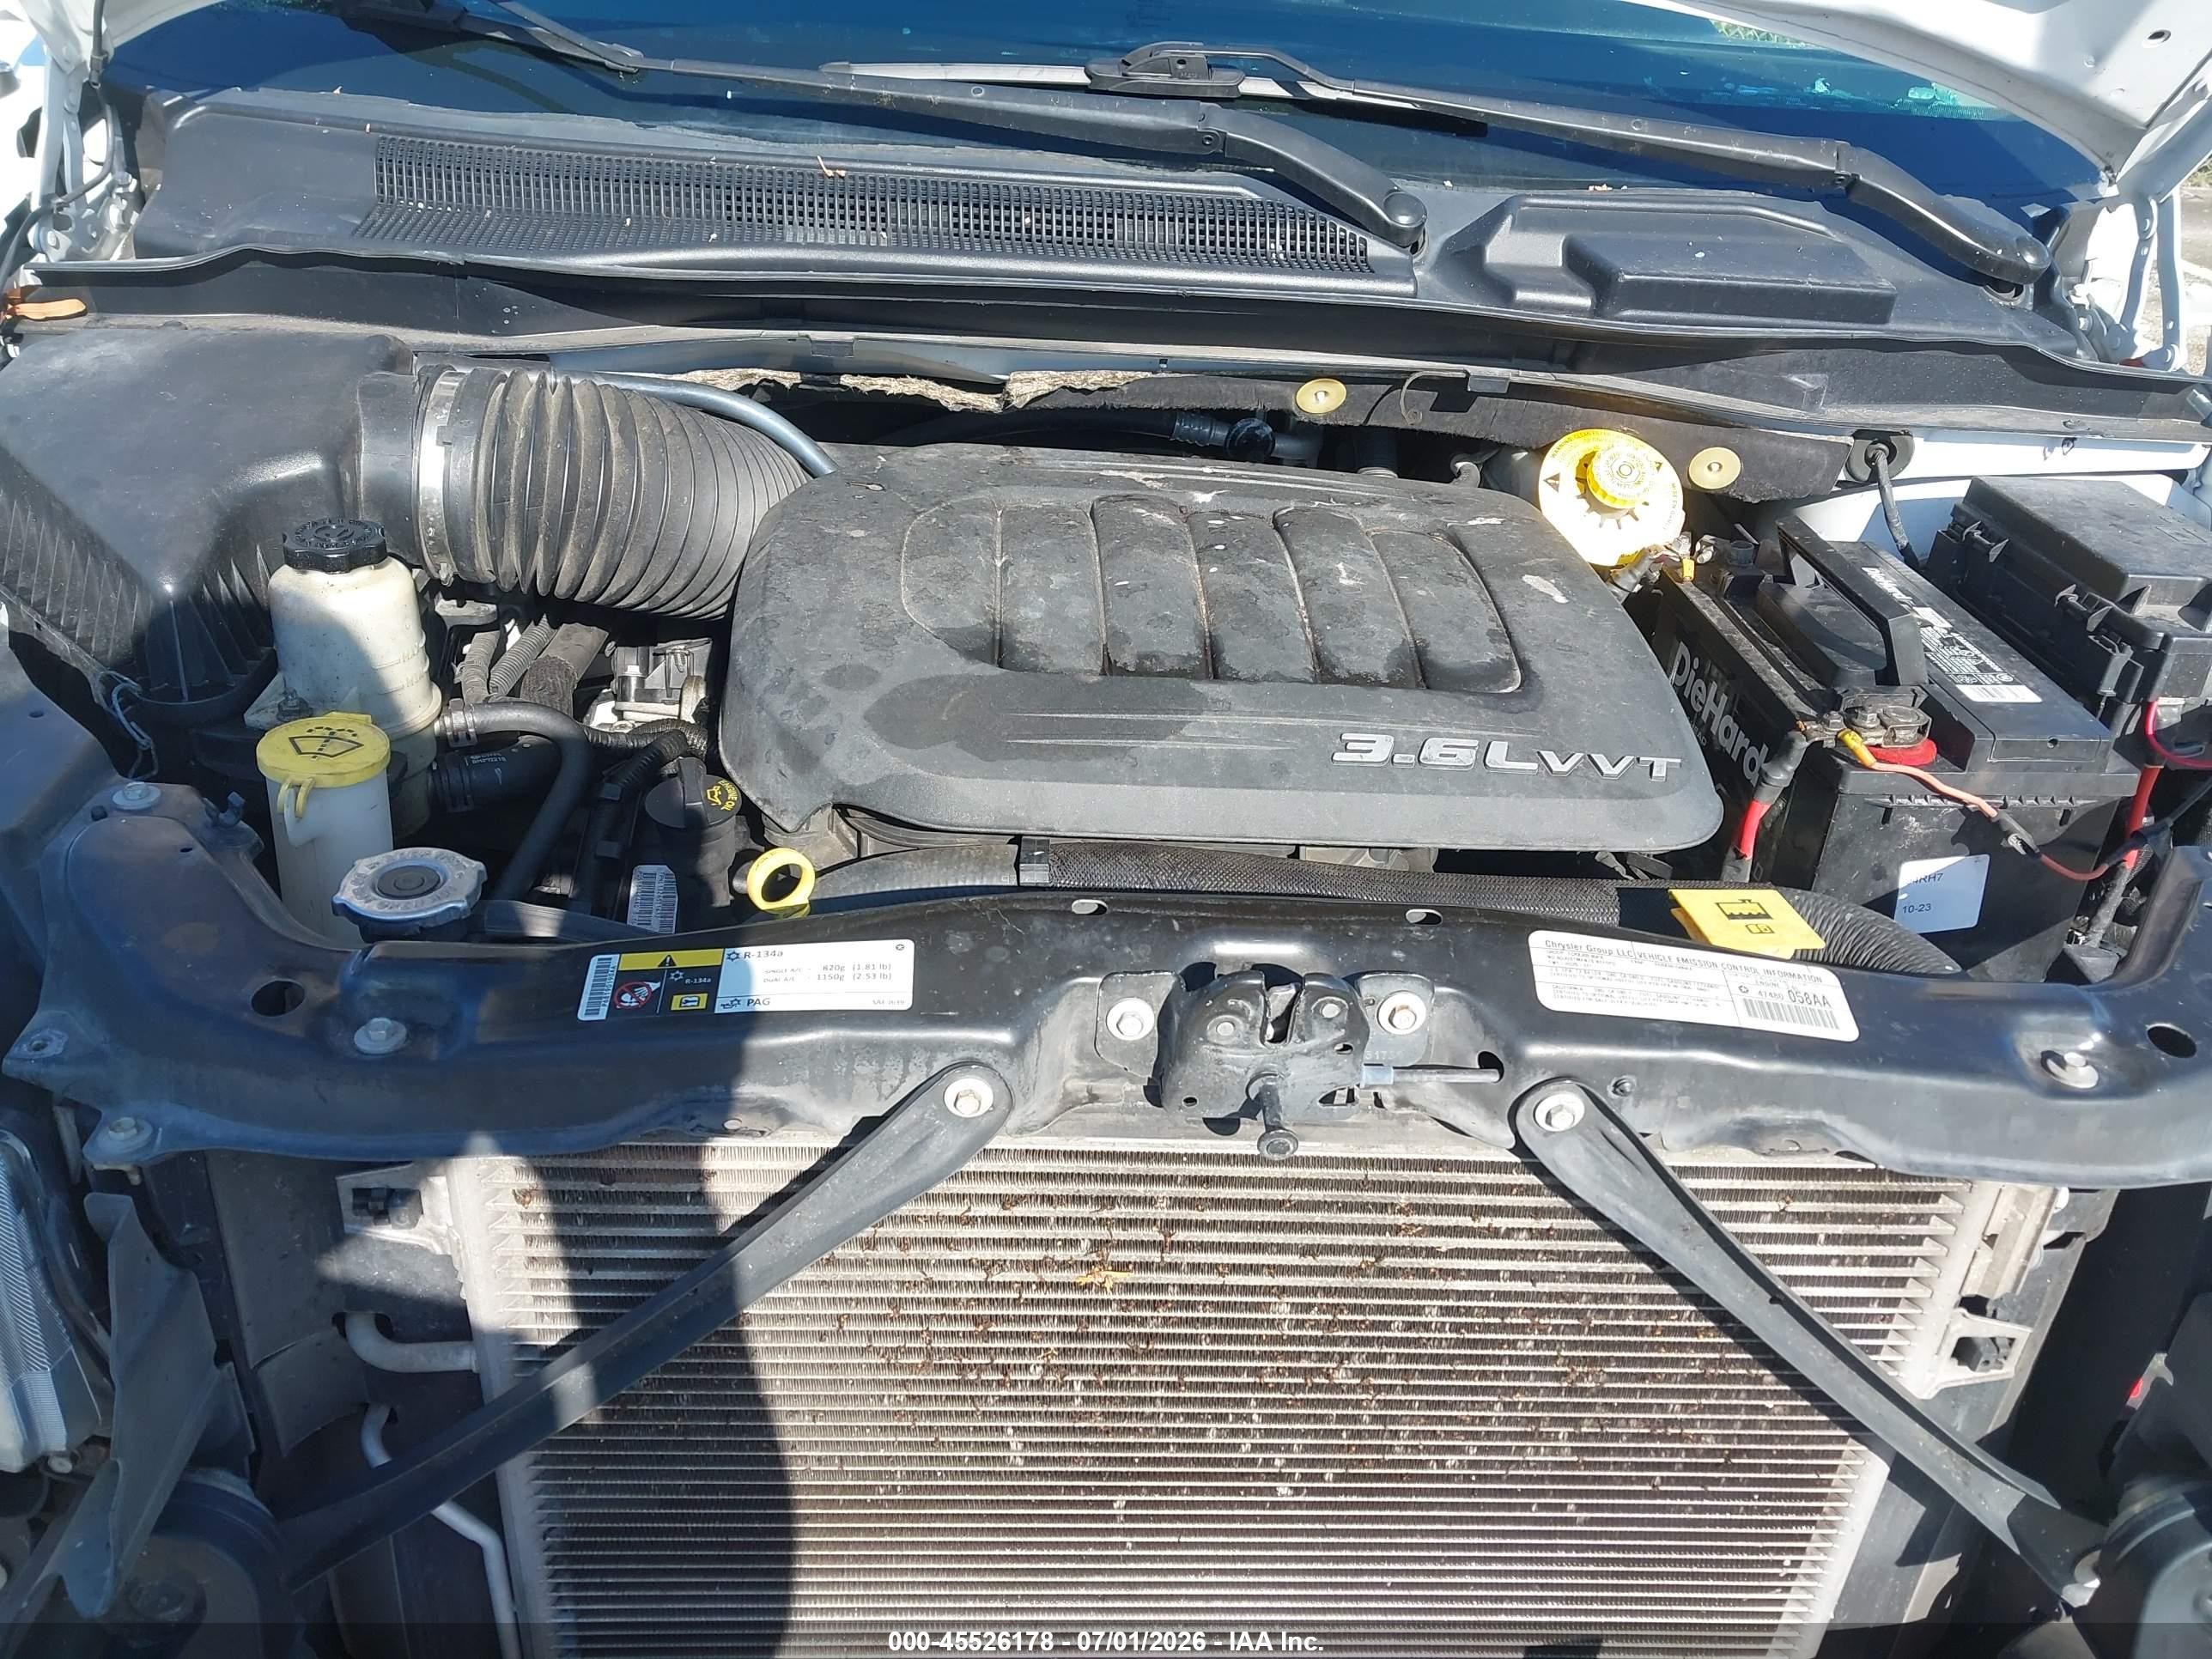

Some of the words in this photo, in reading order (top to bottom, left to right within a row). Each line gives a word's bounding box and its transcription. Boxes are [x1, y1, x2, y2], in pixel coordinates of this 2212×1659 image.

[1861, 567, 1912, 601] DieHard
[1669, 641, 1769, 788] DieHard
[718, 780, 738, 801] ENGINE
[720, 800, 735, 811] OIL
[1901, 902, 1932, 915] 10-23
[1545, 939, 1583, 951] Chrysler
[1586, 945, 1613, 957] Group
[1616, 948, 1634, 957] LLC
[743, 950, 784, 960] R-134a
[823, 963, 846, 973] 820g
[852, 963, 877, 973] (1.81
[878, 962, 892, 971] lb)
[1637, 951, 1673, 963] VEHICLE
[1675, 956, 1718, 969] EMISSION
[1721, 963, 1759, 975] CONTROL
[1763, 968, 1823, 984] INFORMATION
[684, 976, 712, 985] R-134a
[817, 973, 845, 981] 1150g
[853, 972, 878, 981] (2.53
[879, 971, 893, 981] lb)
[746, 997, 771, 1006] PAG
[1787, 988, 1832, 1008] 058AA
